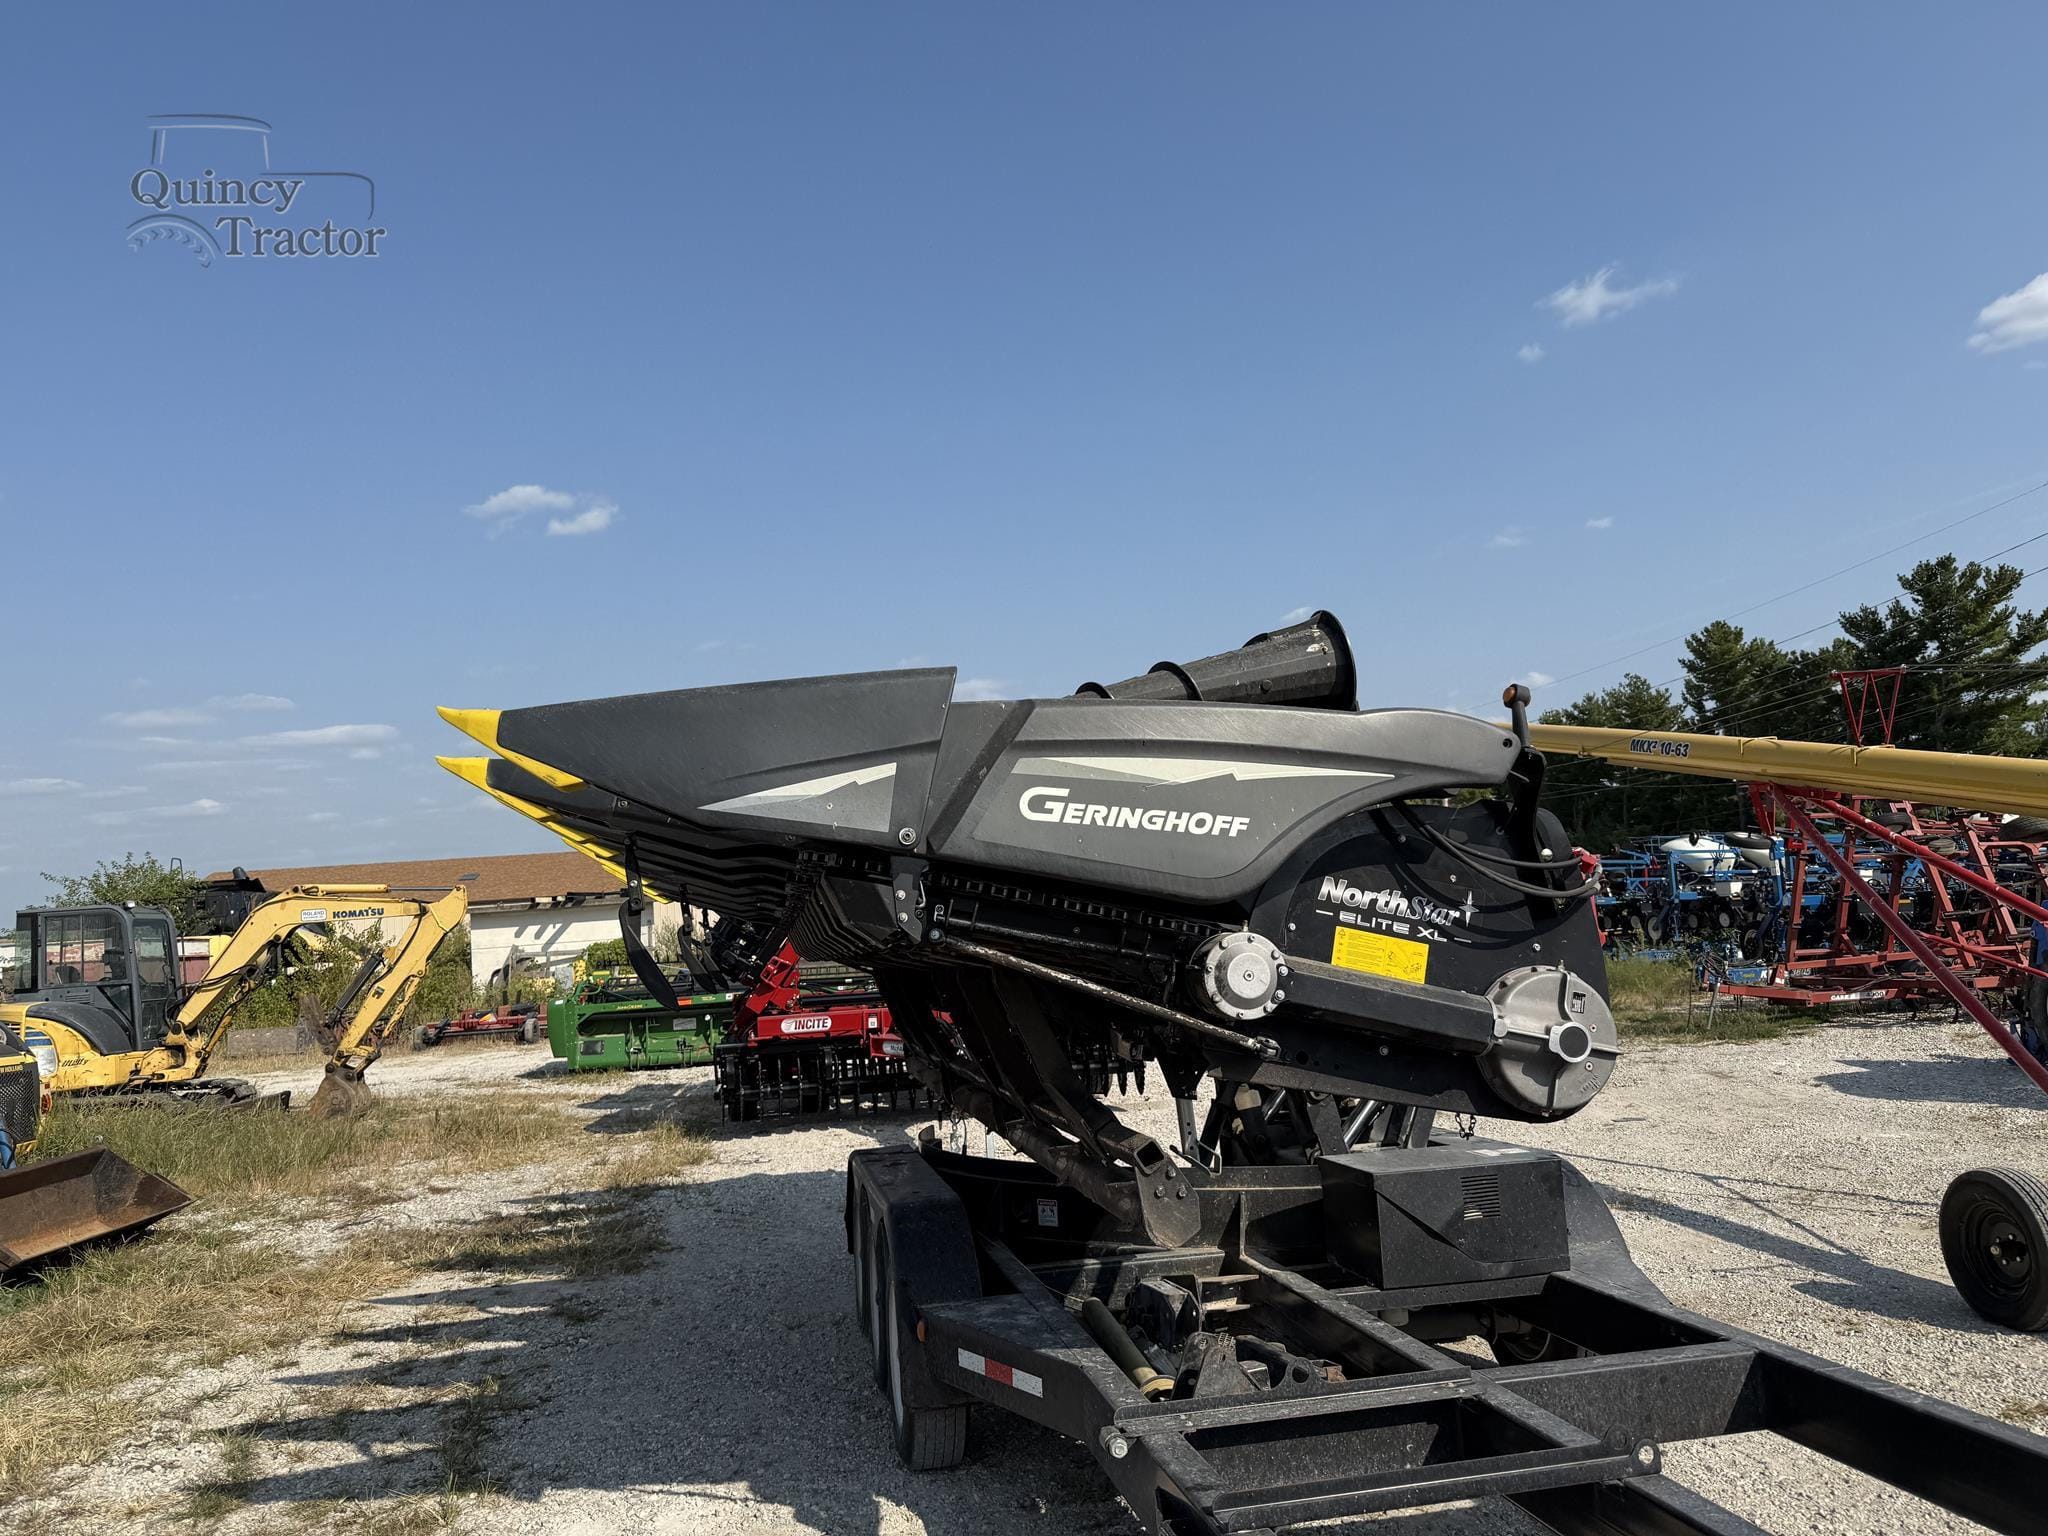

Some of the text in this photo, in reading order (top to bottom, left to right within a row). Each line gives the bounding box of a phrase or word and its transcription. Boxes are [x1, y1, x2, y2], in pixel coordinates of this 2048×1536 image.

[1661, 741, 1689, 757] 10-63
[1019, 786, 1251, 838] GERINGHOFF
[332, 907, 385, 919] KOMATSU
[1338, 910, 1448, 943] ELITE XL
[794, 1016, 829, 1030] INCITE
